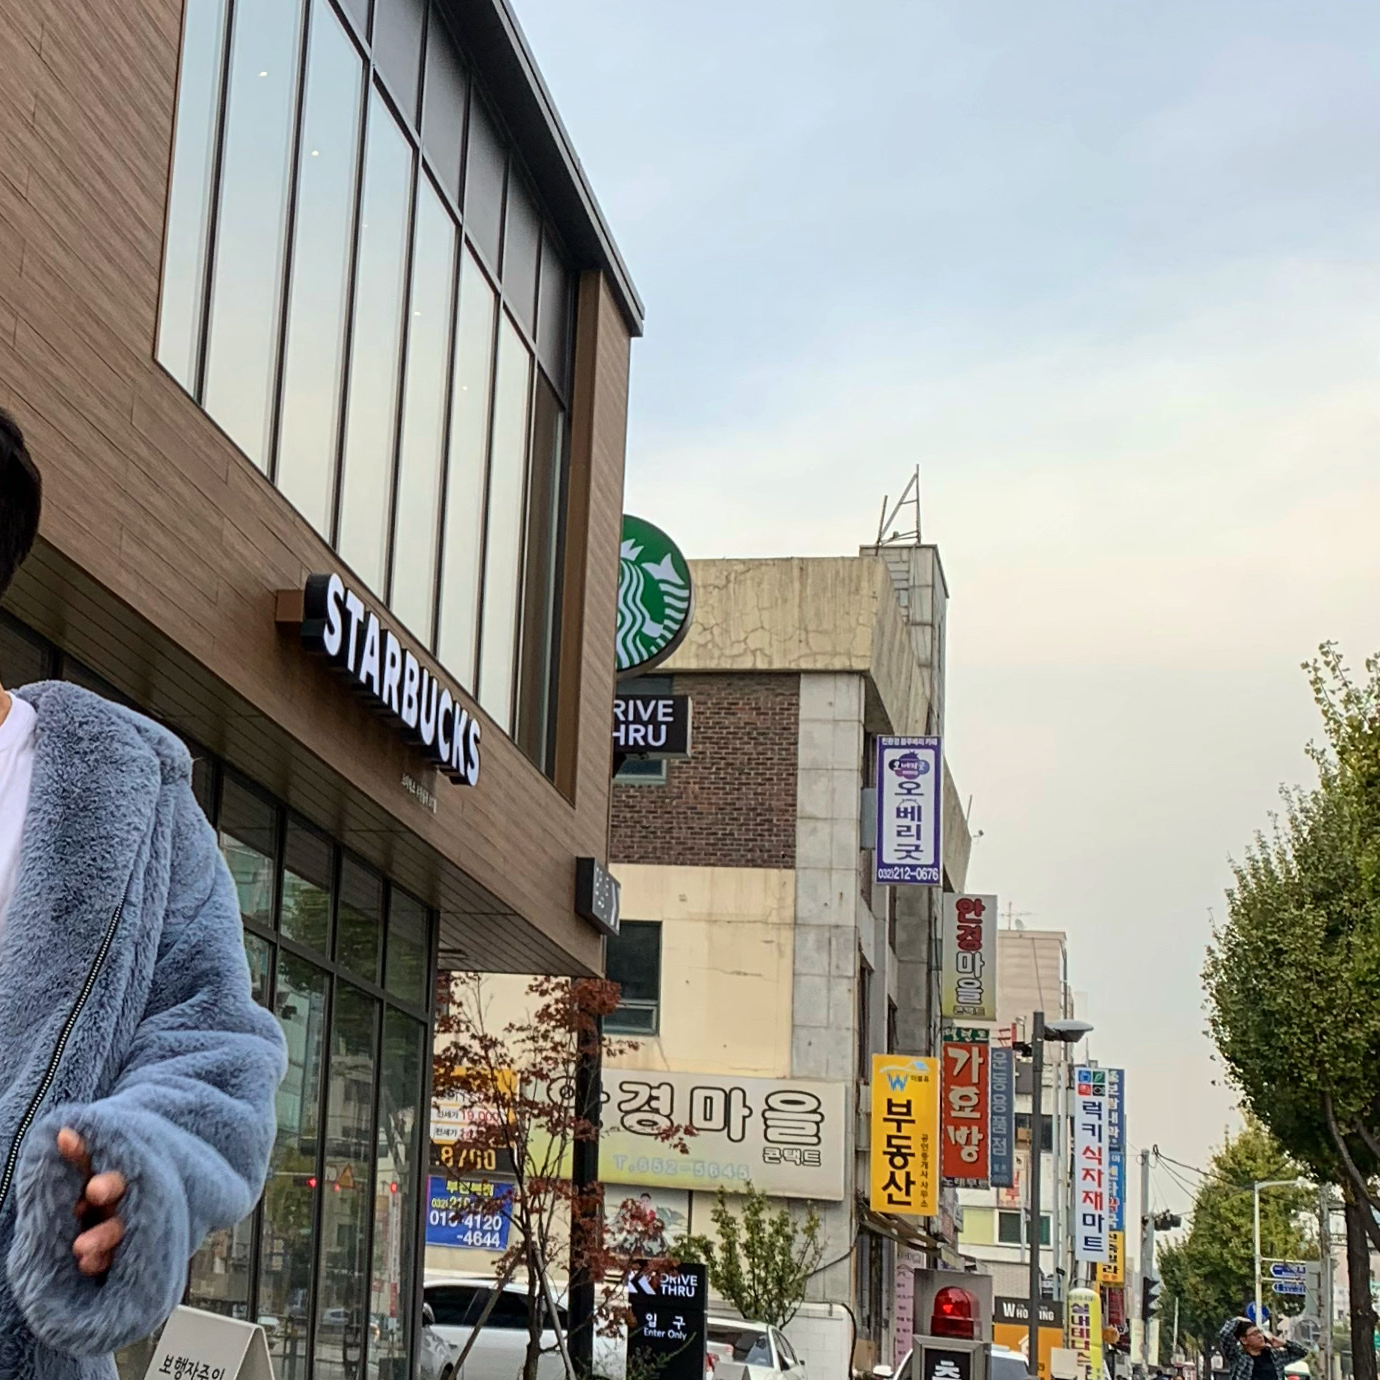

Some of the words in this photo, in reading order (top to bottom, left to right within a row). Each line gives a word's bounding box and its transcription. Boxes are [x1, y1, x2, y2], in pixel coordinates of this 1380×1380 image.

[323, 572, 482, 788] STARBUCKS
[613, 700, 674, 721] RIVE
[612, 724, 667, 747] HRU
[894, 781, 924, 861] 오베리굿
[763, 1147, 822, 1167] 콘택트
[882, 1098, 916, 1206] 부동산
[661, 1284, 695, 1297] THRU
[644, 1327, 665, 1338] Enter
[667, 1329, 687, 1341] Only
[1071, 1303, 1093, 1380] 실내테니스
